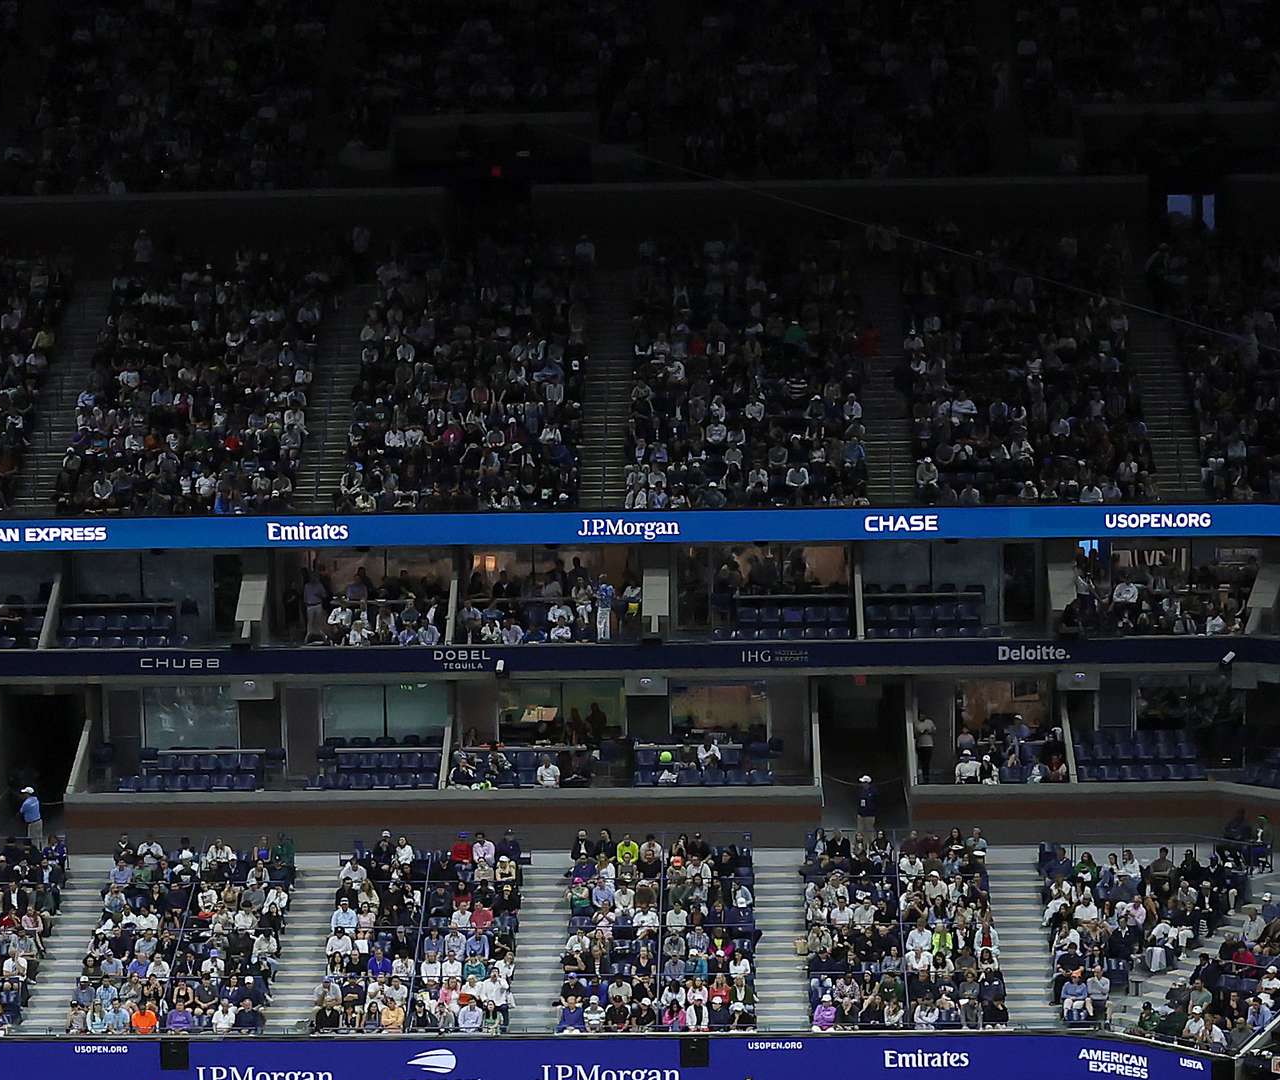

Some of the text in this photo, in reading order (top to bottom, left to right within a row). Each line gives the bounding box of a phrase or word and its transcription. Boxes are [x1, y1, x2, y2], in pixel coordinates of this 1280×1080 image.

[865, 514, 939, 532] CHASE
[1105, 512, 1212, 529] USOPEN.ORG
[25, 527, 106, 542] EXPRESS
[267, 521, 349, 541] Emirates
[578, 518, 679, 541] J.P.Morgan
[433, 649, 491, 661] DOBEL
[741, 650, 771, 663] IHG
[997, 645, 1071, 661] Deloitte.
[139, 657, 221, 670] CHUBB
[443, 662, 483, 671] TEQUILA
[74, 1044, 129, 1054] USOPEN.ORG
[748, 1041, 803, 1051] USOPEN.ORG
[884, 1048, 969, 1068] Emirates
[1078, 1048, 1147, 1067] AMERICAN
[1180, 1057, 1204, 1071] USTA
[1088, 1060, 1149, 1079] EXPRESS
